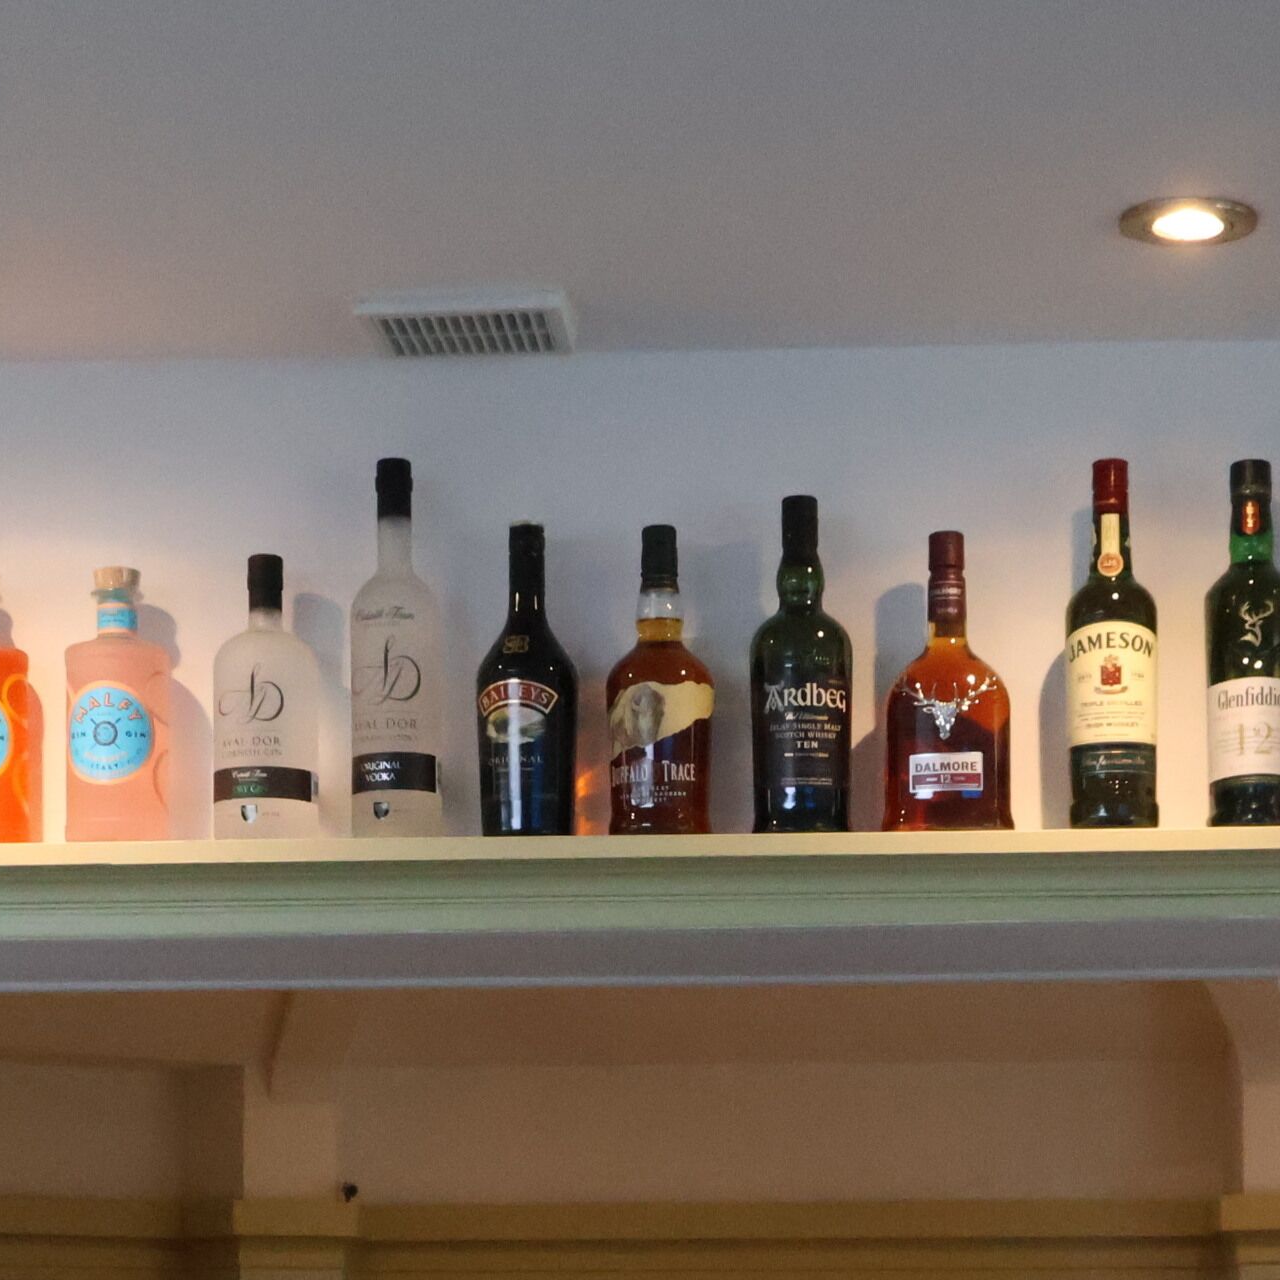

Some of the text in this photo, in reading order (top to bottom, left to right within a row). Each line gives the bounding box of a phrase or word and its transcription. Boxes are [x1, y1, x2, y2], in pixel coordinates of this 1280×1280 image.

[1069, 631, 1153, 662] JAMESON
[481, 683, 551, 708] BAIEYS
[75, 692, 144, 725] MALFY
[385, 718, 418, 729] DOR
[125, 730, 147, 739] GIN
[1234, 720, 1273, 757] 12
[252, 735, 281, 747] DOR
[796, 741, 819, 749] TEN
[661, 760, 696, 782] TRACE
[914, 761, 977, 773] DALMORE
[364, 772, 396, 782] VODKA
[939, 774, 952, 783] 12
